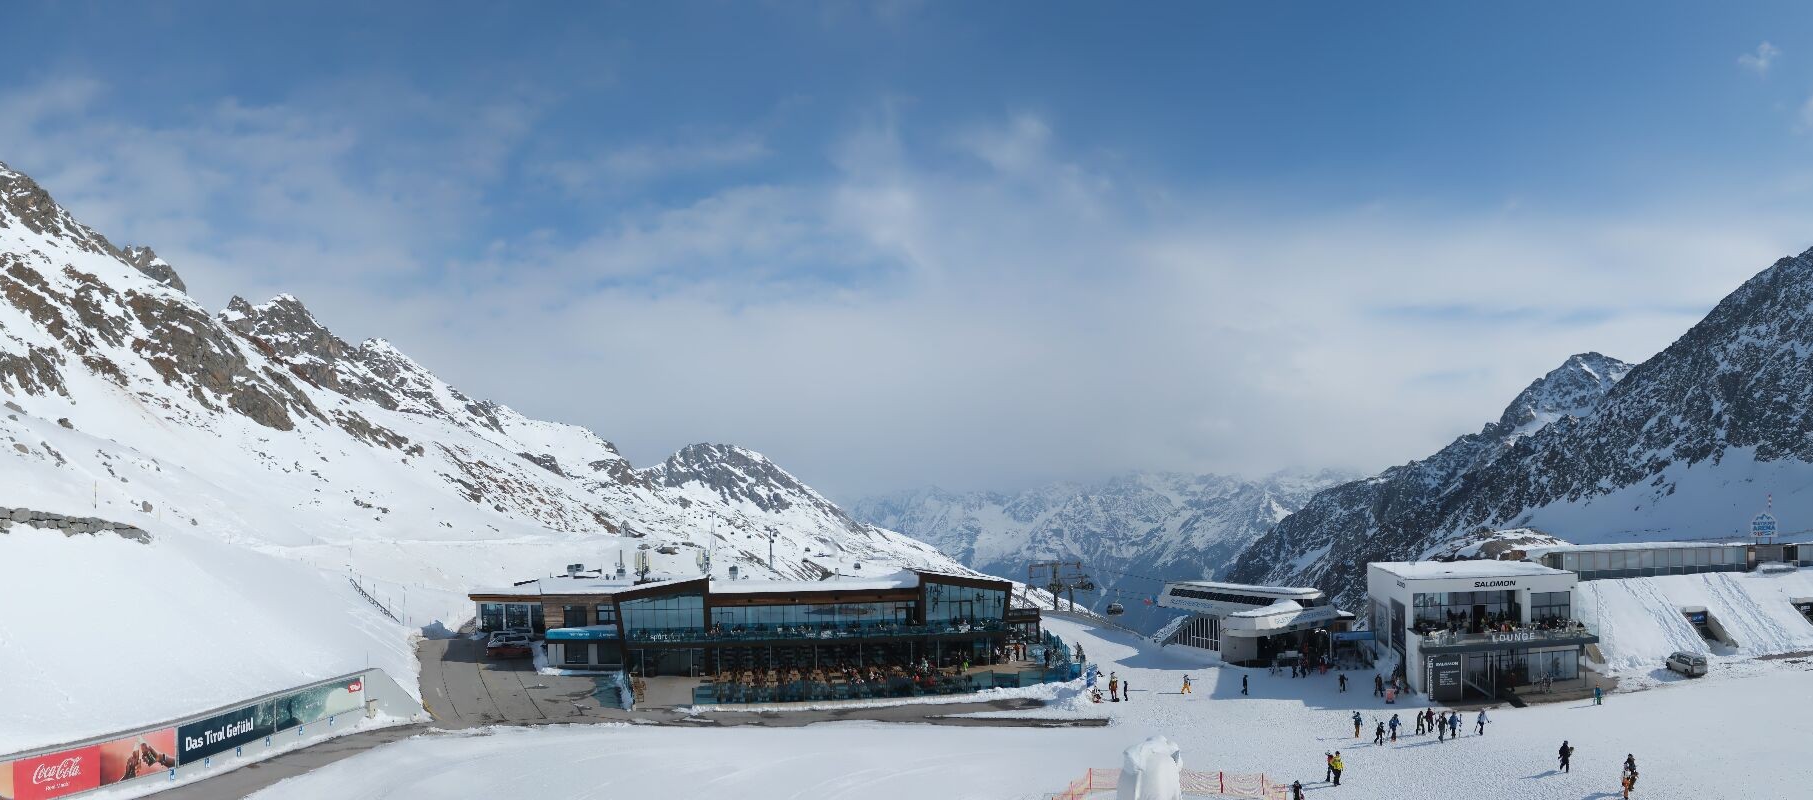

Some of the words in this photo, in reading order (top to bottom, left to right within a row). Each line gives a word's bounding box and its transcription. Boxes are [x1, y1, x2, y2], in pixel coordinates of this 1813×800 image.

[1474, 580, 1516, 588] SALOMON
[1492, 632, 1535, 642] LOUNGE
[185, 736, 204, 752] Das
[204, 726, 226, 746] Tirol
[226, 717, 254, 738] Gefühl
